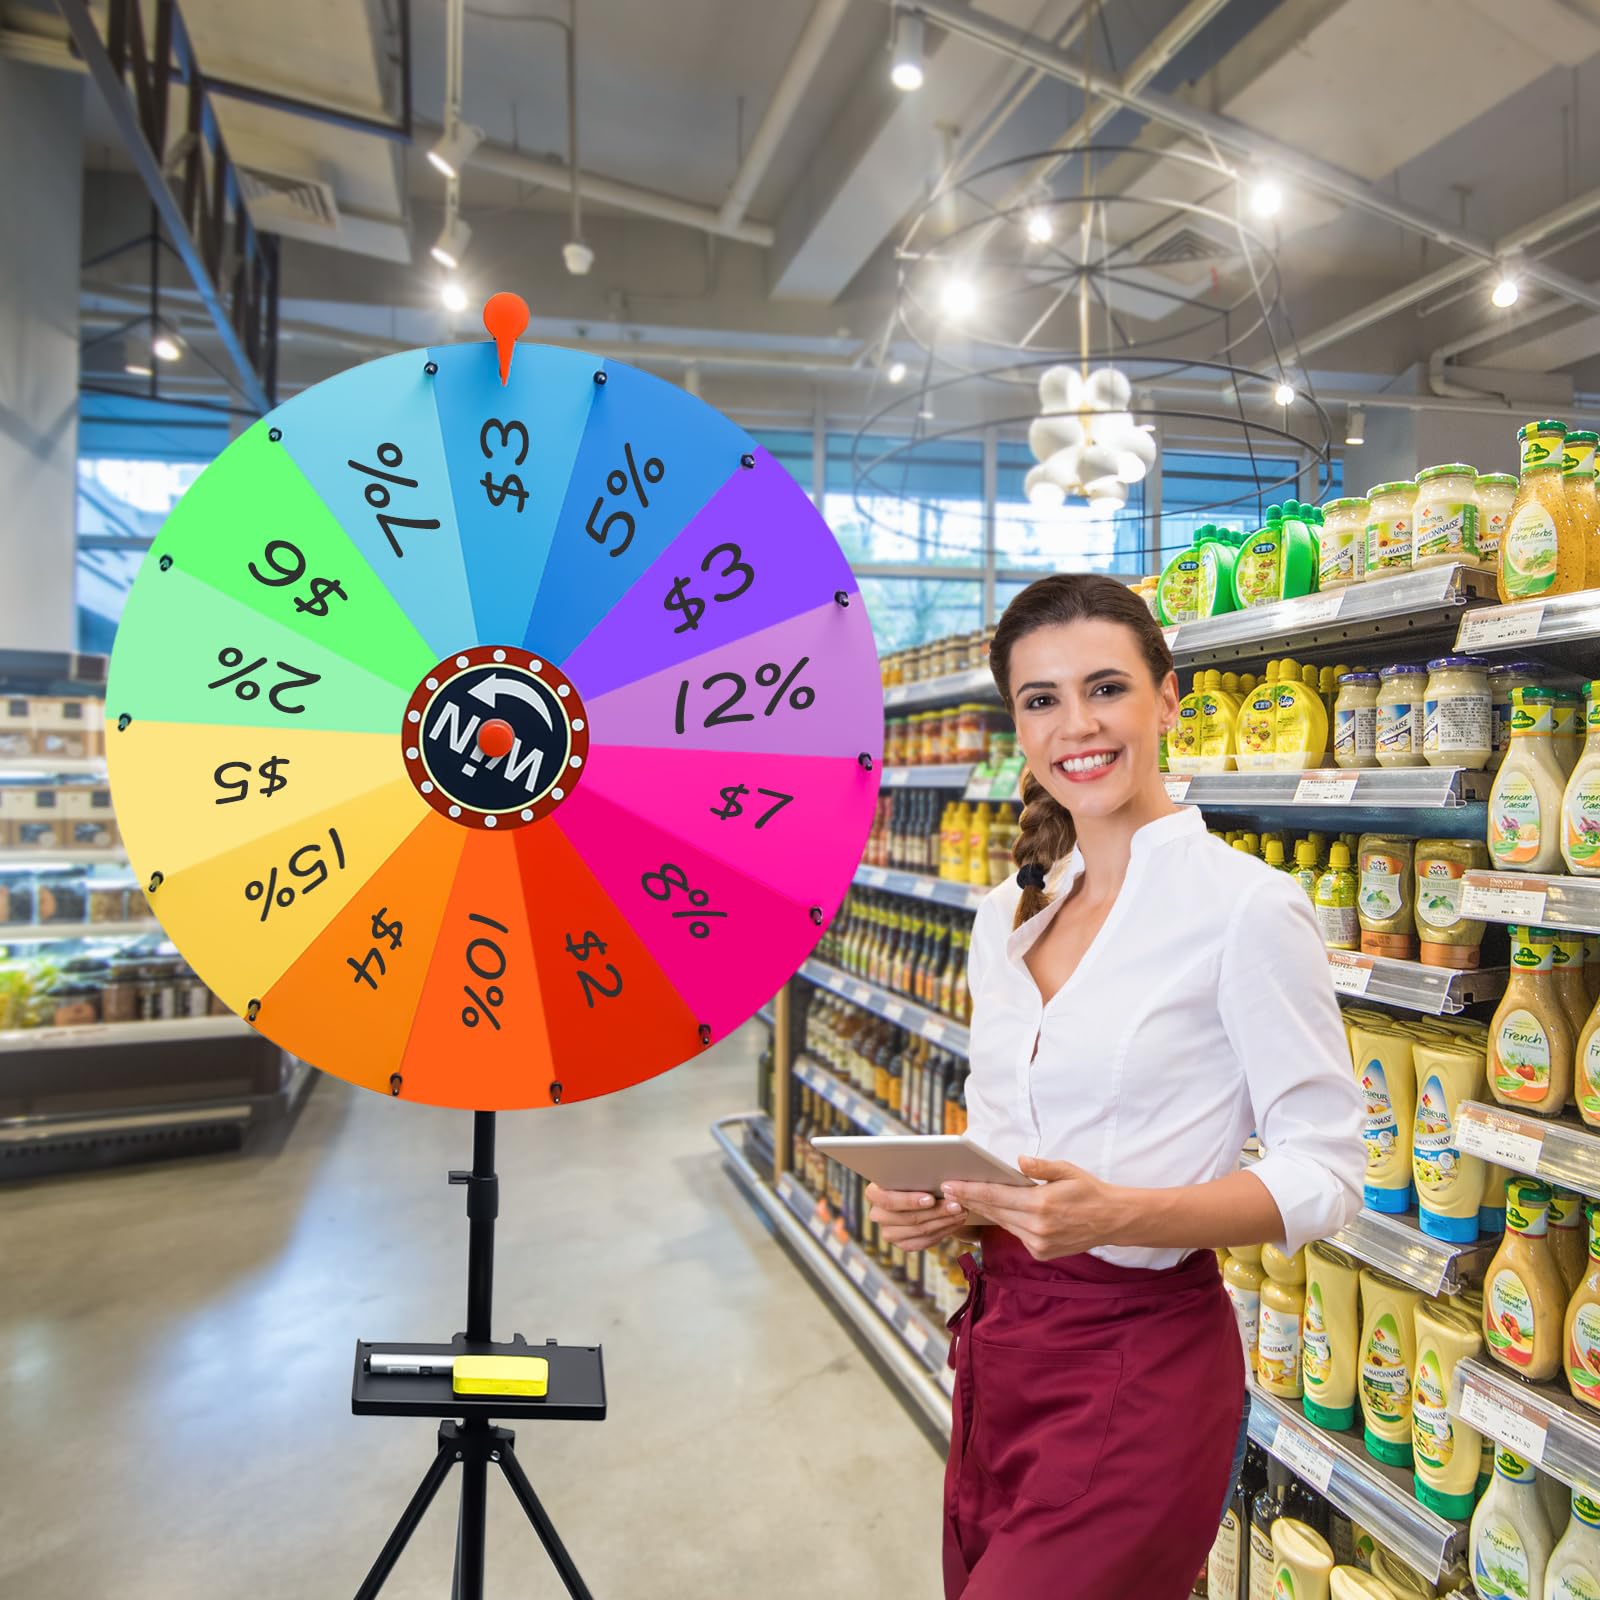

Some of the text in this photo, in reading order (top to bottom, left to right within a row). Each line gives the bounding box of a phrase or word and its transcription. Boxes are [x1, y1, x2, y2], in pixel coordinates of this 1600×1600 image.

[347, 443, 441, 558] 7%
[480, 418, 529, 513] $3
[586, 443, 665, 558] 5%
[1530, 529, 1552, 539] Herbs
[249, 541, 348, 616] $6
[664, 543, 755, 634] $3
[208, 646, 322, 714] 2%
[675, 656, 817, 735] 12%
[214, 756, 290, 804] $5
[711, 784, 794, 830] $7
[1499, 792, 1532, 801] American
[1504, 801, 1530, 809] Caesar
[245, 828, 345, 922] 15%
[642, 863, 727, 939] 8%
[348, 907, 403, 990] $4
[461, 913, 508, 1030] 10%
[567, 931, 623, 1008] $2
[1503, 1027, 1542, 1045] French
[1494, 1284, 1528, 1306] Thousand
[1484, 1527, 1521, 1555] Yoghurt
